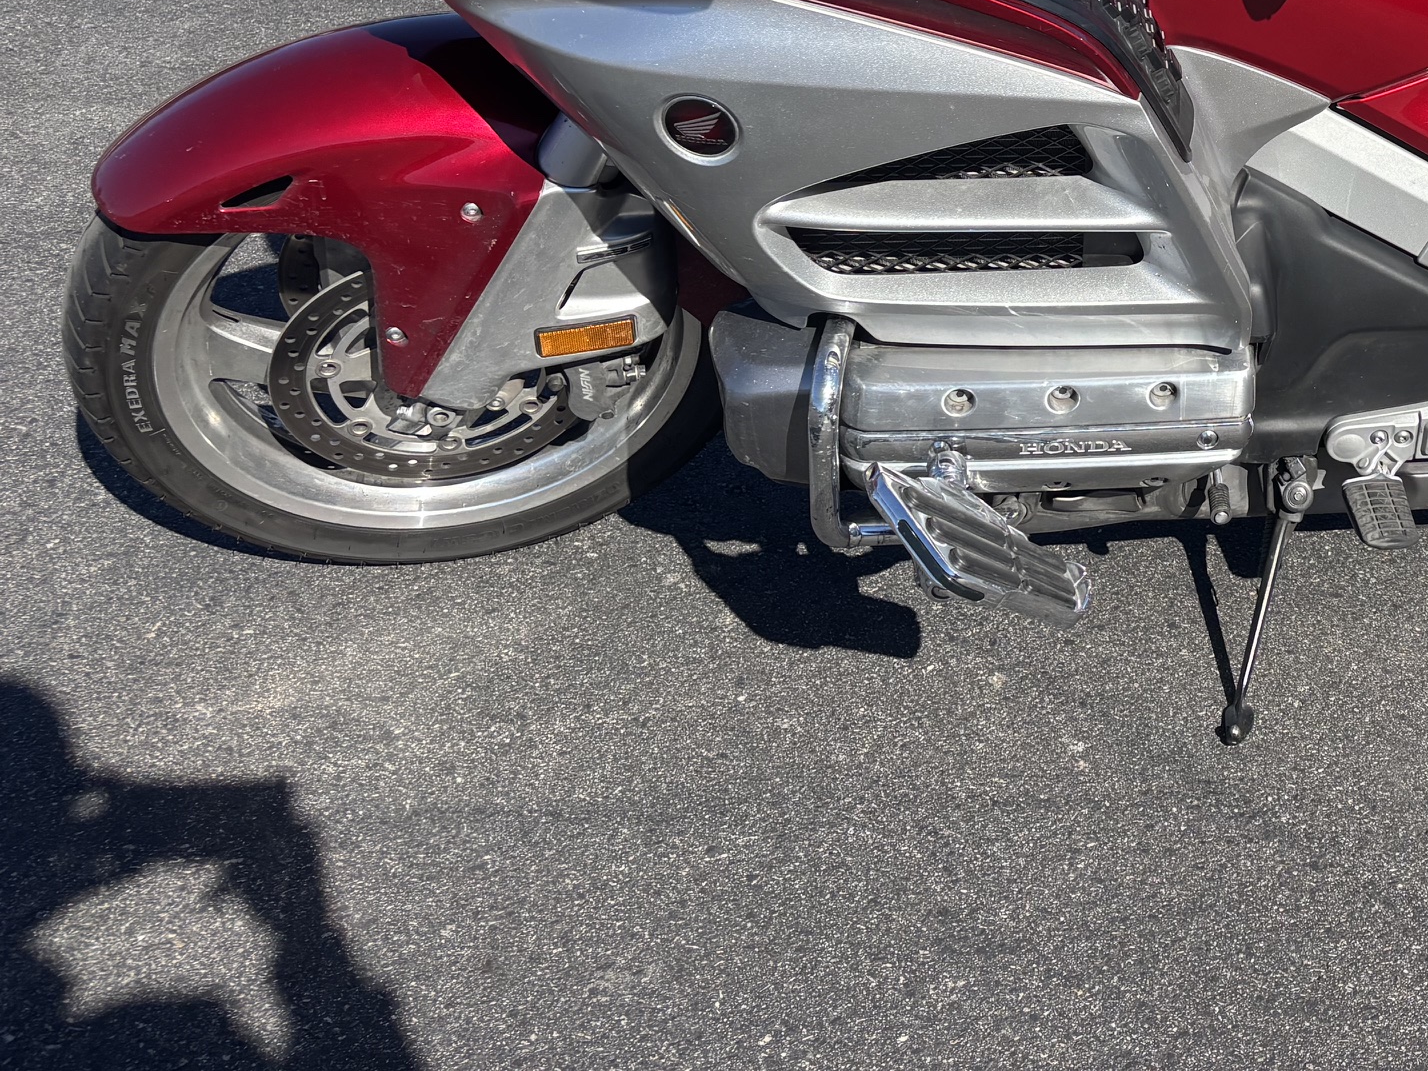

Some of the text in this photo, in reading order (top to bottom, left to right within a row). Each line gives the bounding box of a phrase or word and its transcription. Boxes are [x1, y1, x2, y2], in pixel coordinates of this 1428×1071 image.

[119, 297, 153, 433] EXEDRA MAX
[1019, 438, 1132, 455] HONDA
